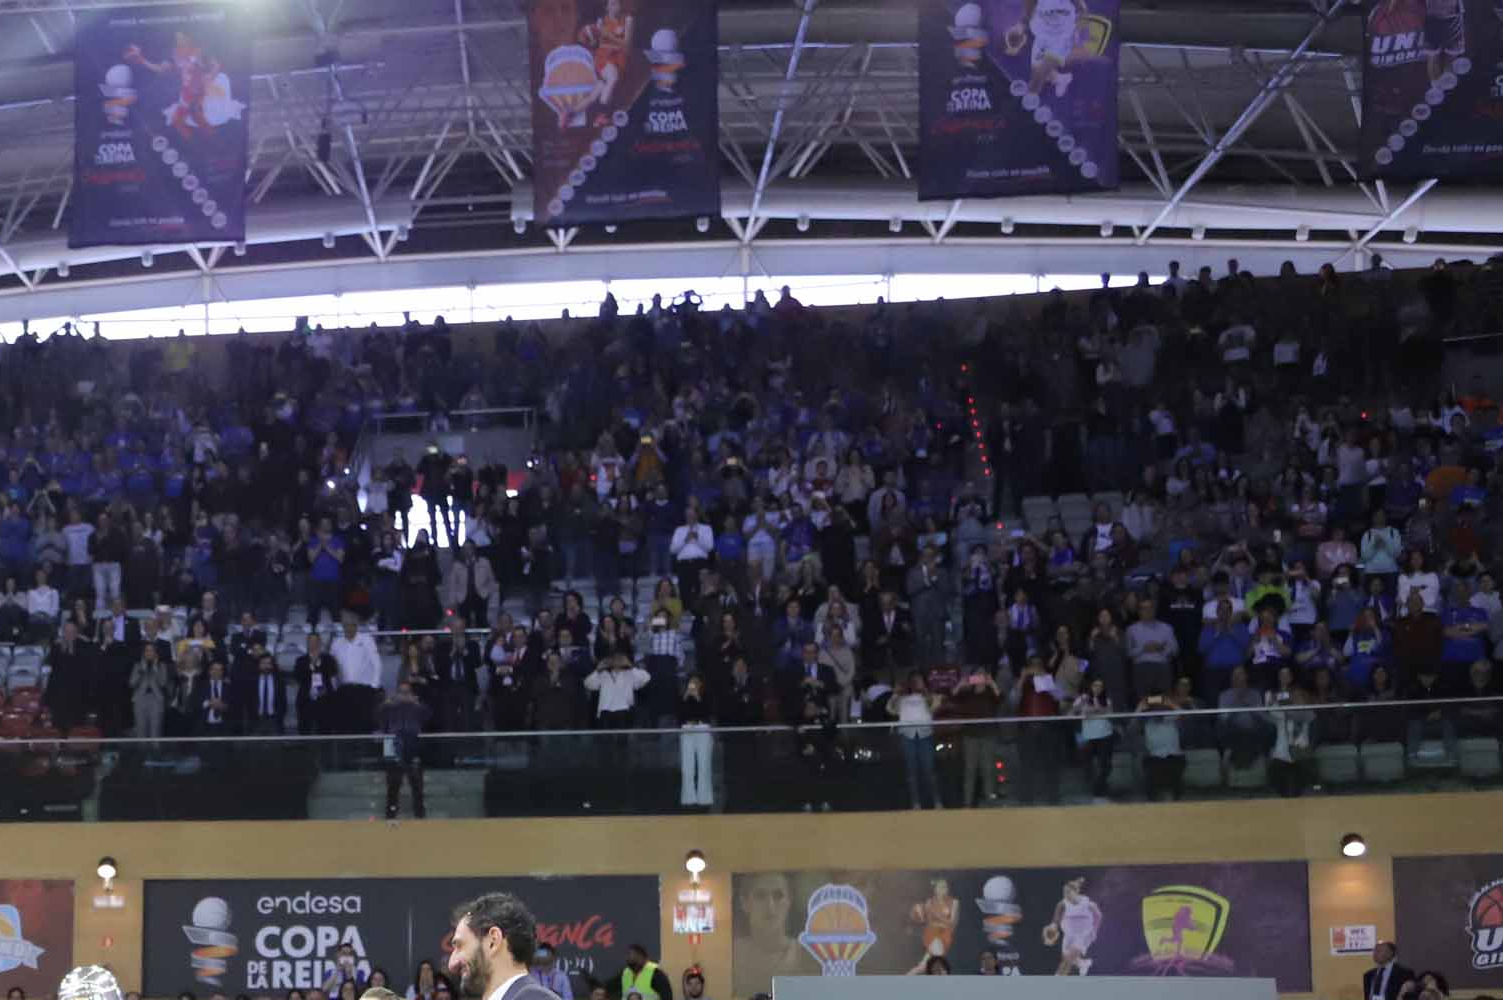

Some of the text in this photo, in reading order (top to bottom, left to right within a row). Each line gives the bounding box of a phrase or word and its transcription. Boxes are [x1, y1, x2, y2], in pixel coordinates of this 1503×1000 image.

[951, 88, 987, 101] COPA
[649, 110, 683, 122] COPA
[256, 891, 362, 914] endesa
[255, 925, 366, 958] COPA
[247, 960, 267, 975] DE
[247, 975, 269, 989] LA
